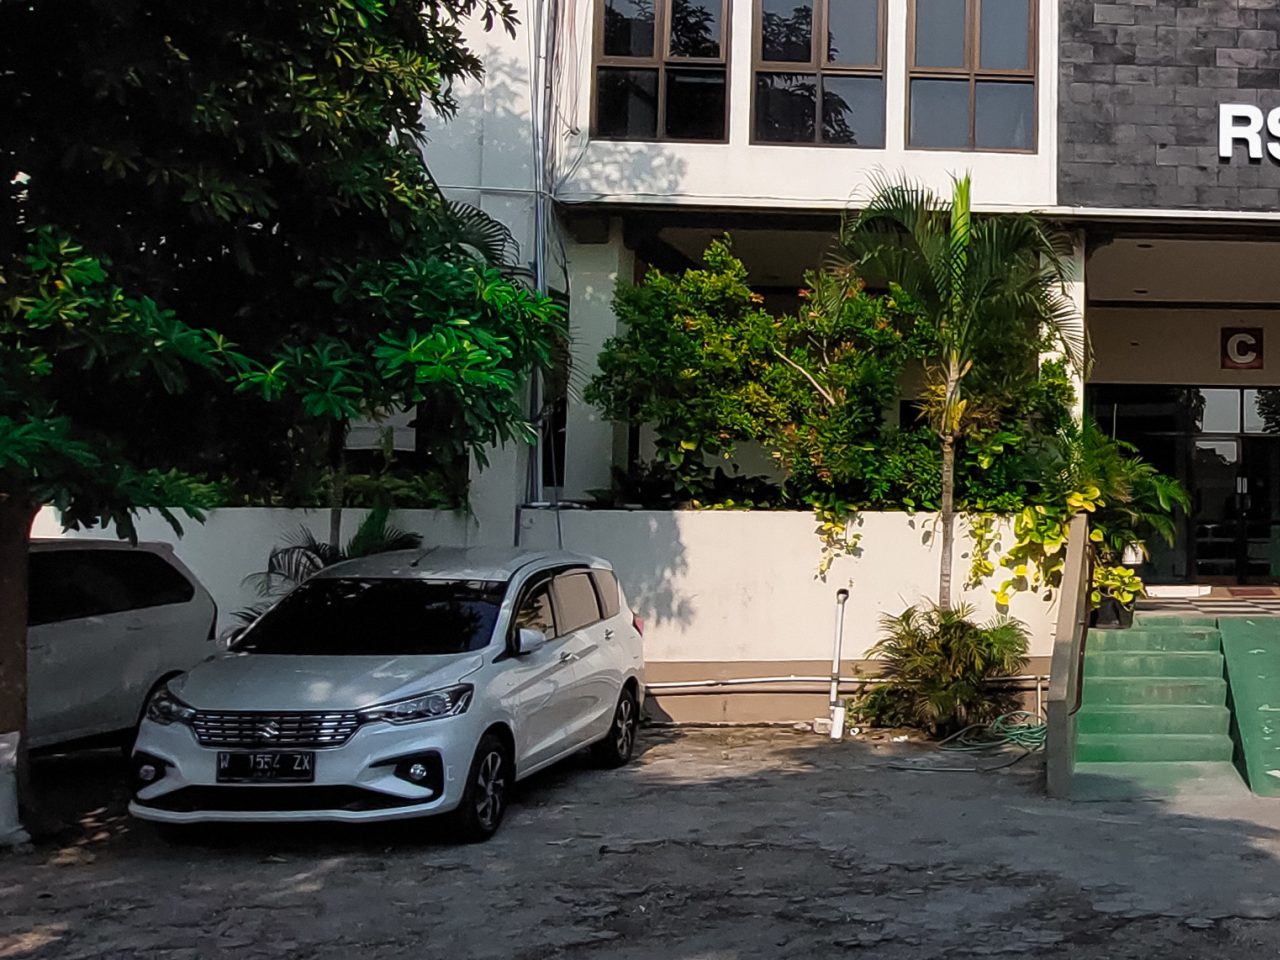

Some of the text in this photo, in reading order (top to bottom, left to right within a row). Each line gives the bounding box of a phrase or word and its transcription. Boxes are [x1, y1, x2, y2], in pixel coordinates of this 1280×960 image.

[1227, 332, 1257, 364] C
[220, 753, 230, 769] W
[293, 754, 310, 770] ZX
